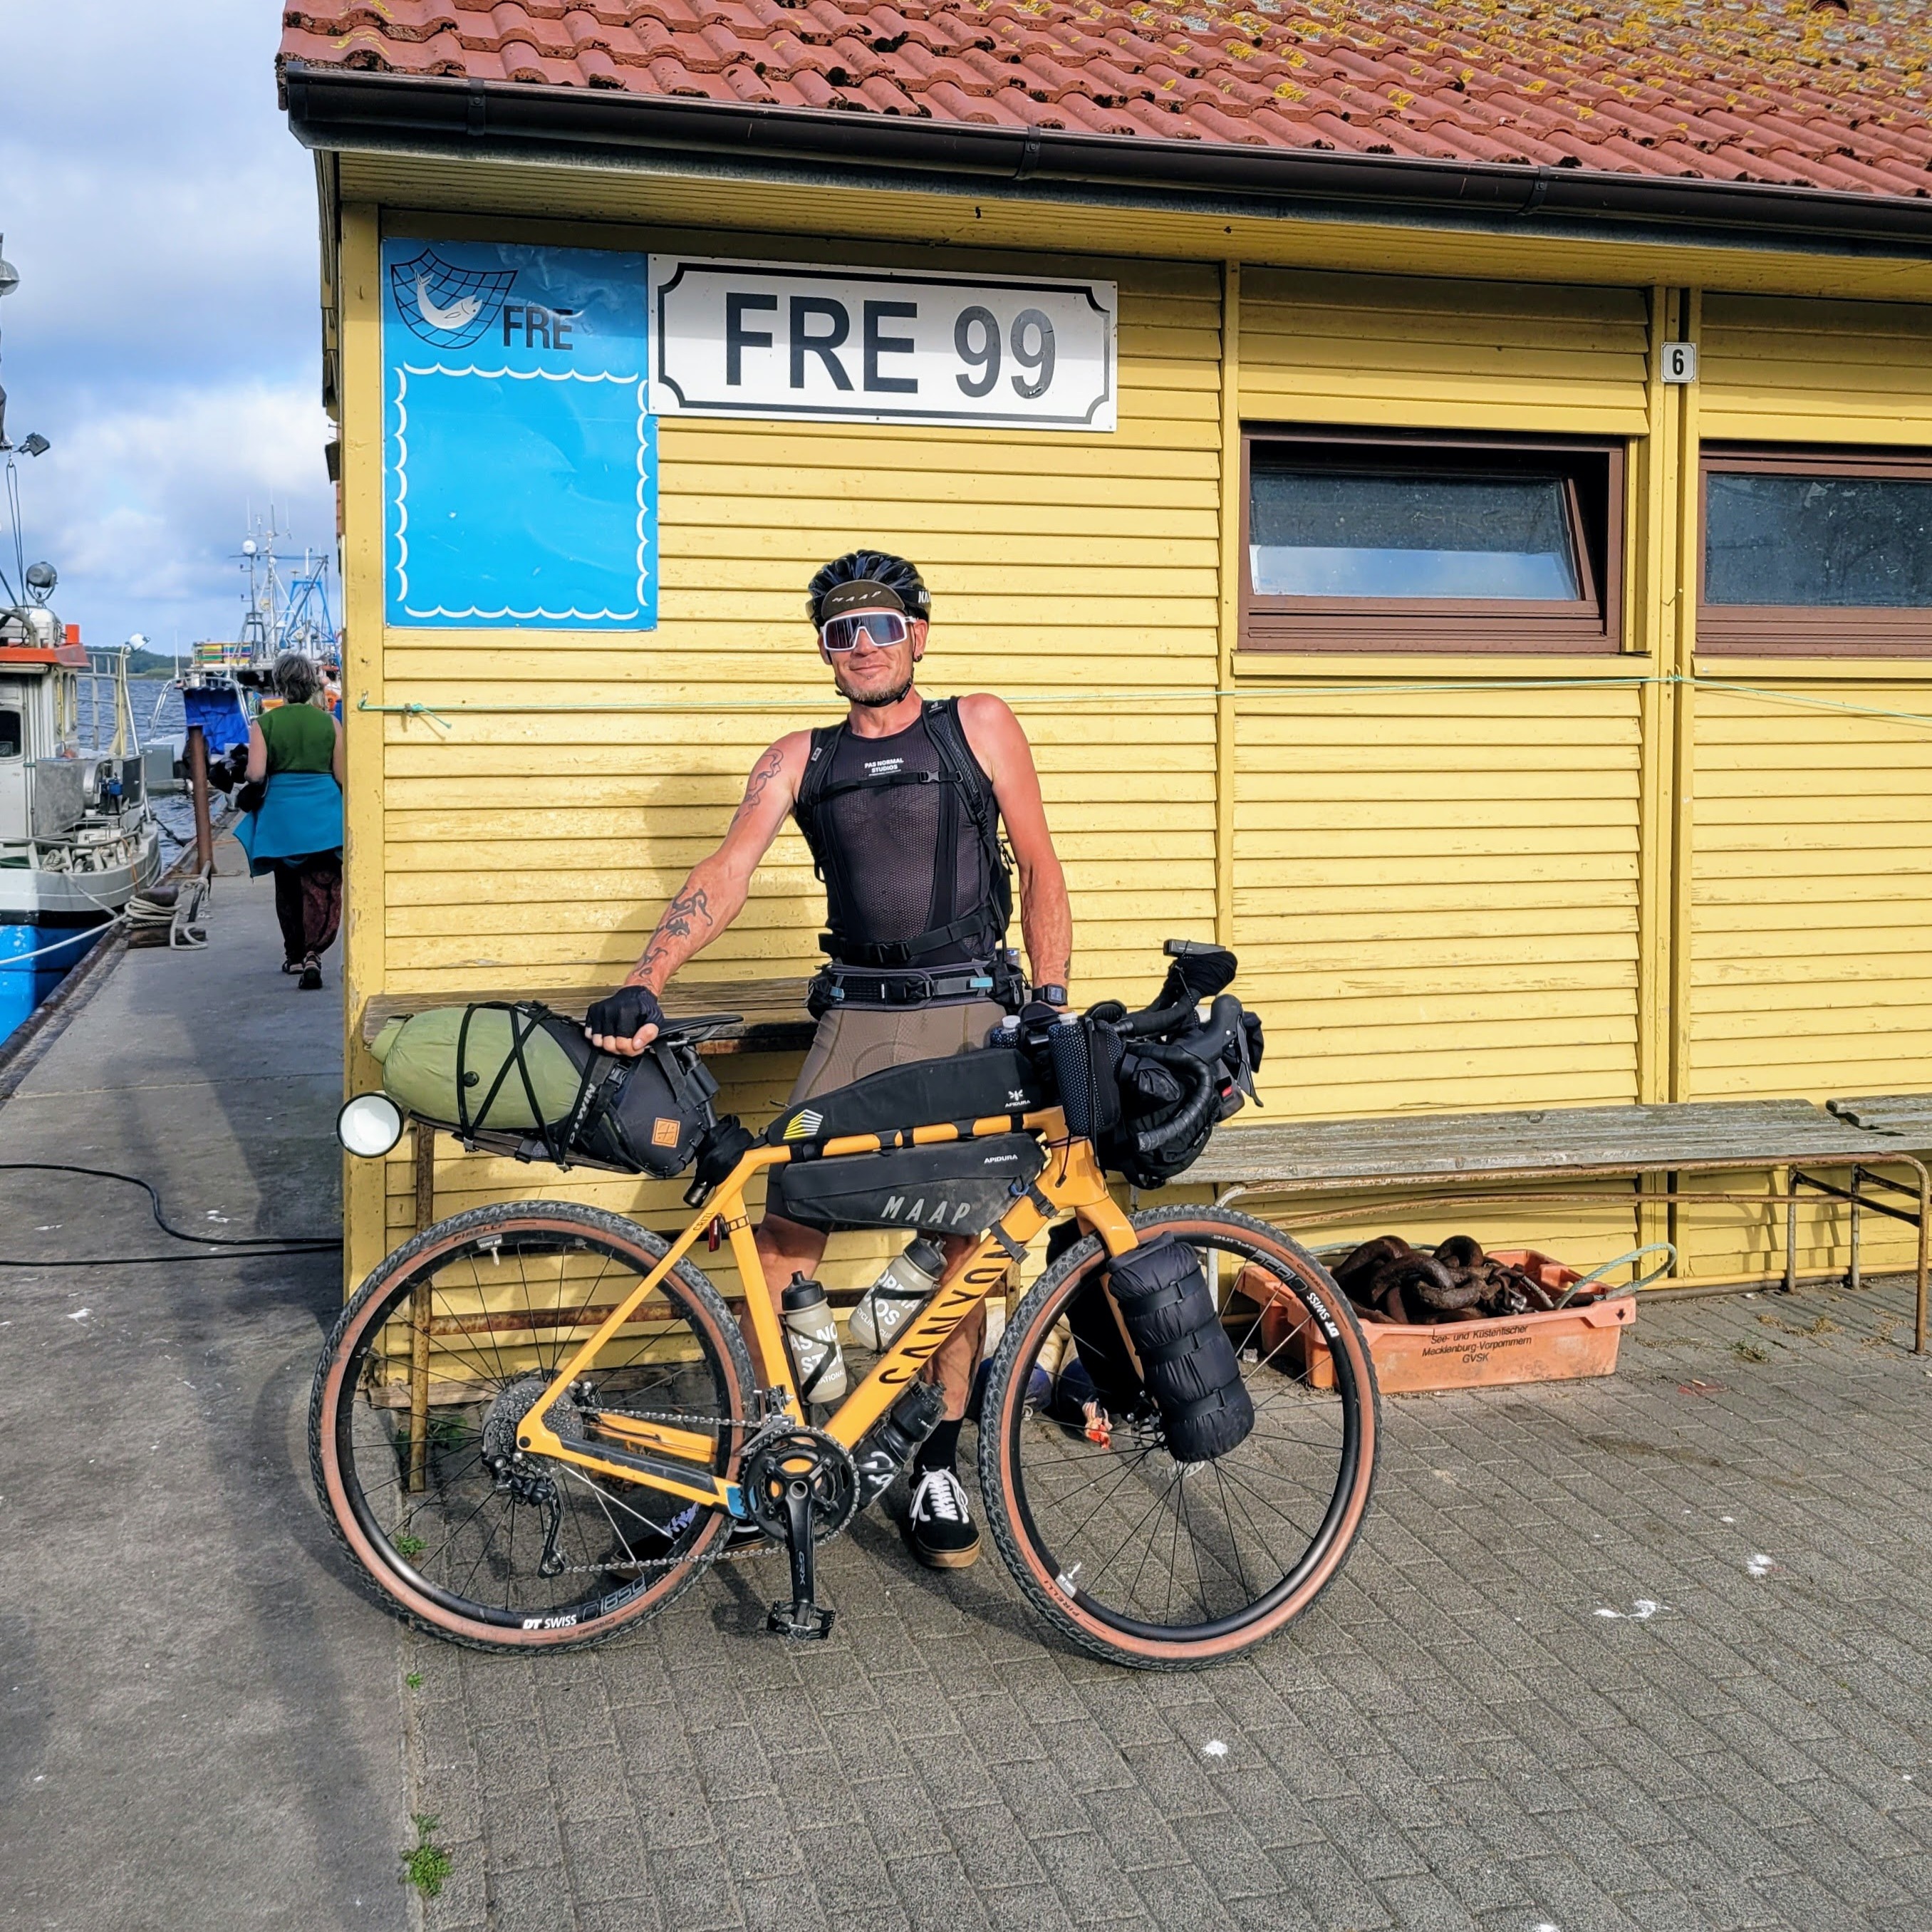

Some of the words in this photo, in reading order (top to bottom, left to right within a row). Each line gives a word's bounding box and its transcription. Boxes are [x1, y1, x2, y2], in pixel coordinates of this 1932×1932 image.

[503, 304, 573, 350] FRE
[726, 292, 918, 394] FRE
[954, 305, 1056, 399] 99
[1672, 348, 1684, 376] 6
[831, 590, 882, 603] MAAP
[871, 764, 898, 773] STUDIOS
[877, 757, 904, 767] NORMAL
[1004, 1099, 1031, 1108] APIDURA
[984, 1153, 1018, 1164] APIDURA
[881, 1195, 971, 1225] MAAP
[878, 1239, 1032, 1384] CANYON
[1307, 1292, 1330, 1320] SWISS
[1324, 1321, 1340, 1338] DT
[1430, 1334, 1450, 1345] See-
[1453, 1331, 1470, 1341] und
[1422, 1336, 1532, 1357] Mecklenburg-Vorpommern
[1463, 1352, 1490, 1364] GVSK
[1044, 1579, 1080, 1617] PIRELLI
[522, 1619, 542, 1630] DT
[544, 1614, 577, 1629] SWISS
